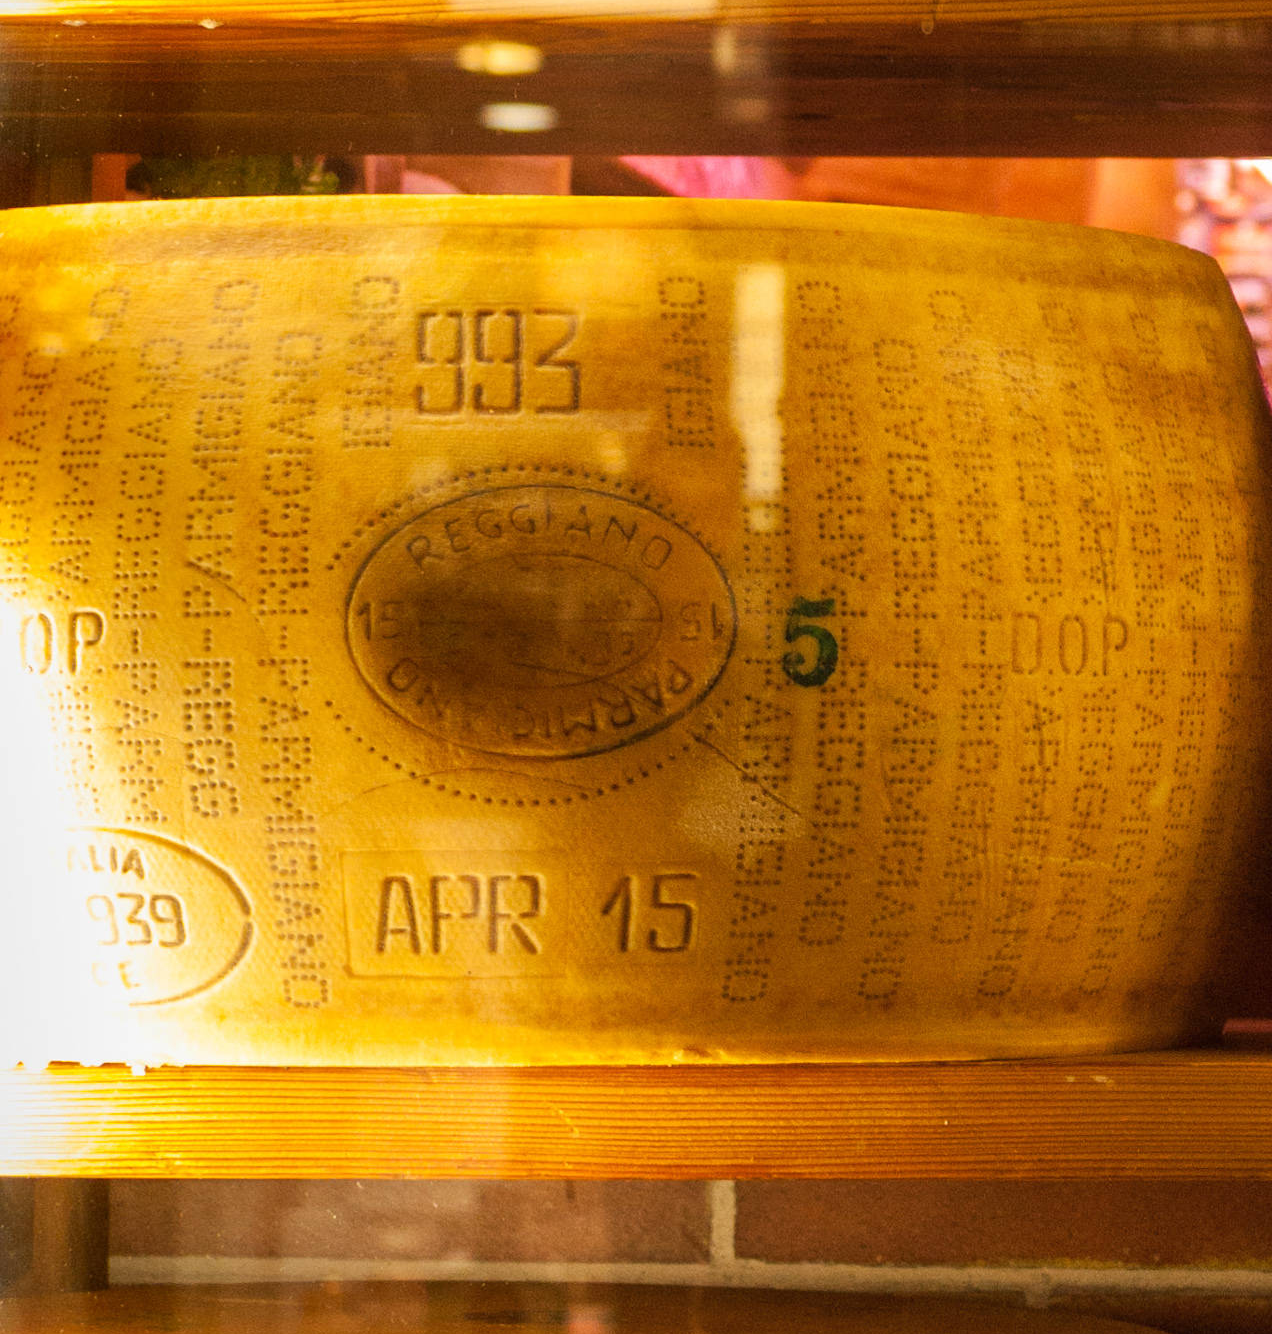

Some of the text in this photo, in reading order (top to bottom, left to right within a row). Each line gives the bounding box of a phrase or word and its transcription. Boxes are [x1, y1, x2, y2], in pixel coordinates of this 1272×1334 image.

[413, 307, 582, 418] 993
[406, 504, 672, 569] REGGIANO
[782, 594, 839, 688] 5
[374, 871, 700, 957] APR 15
